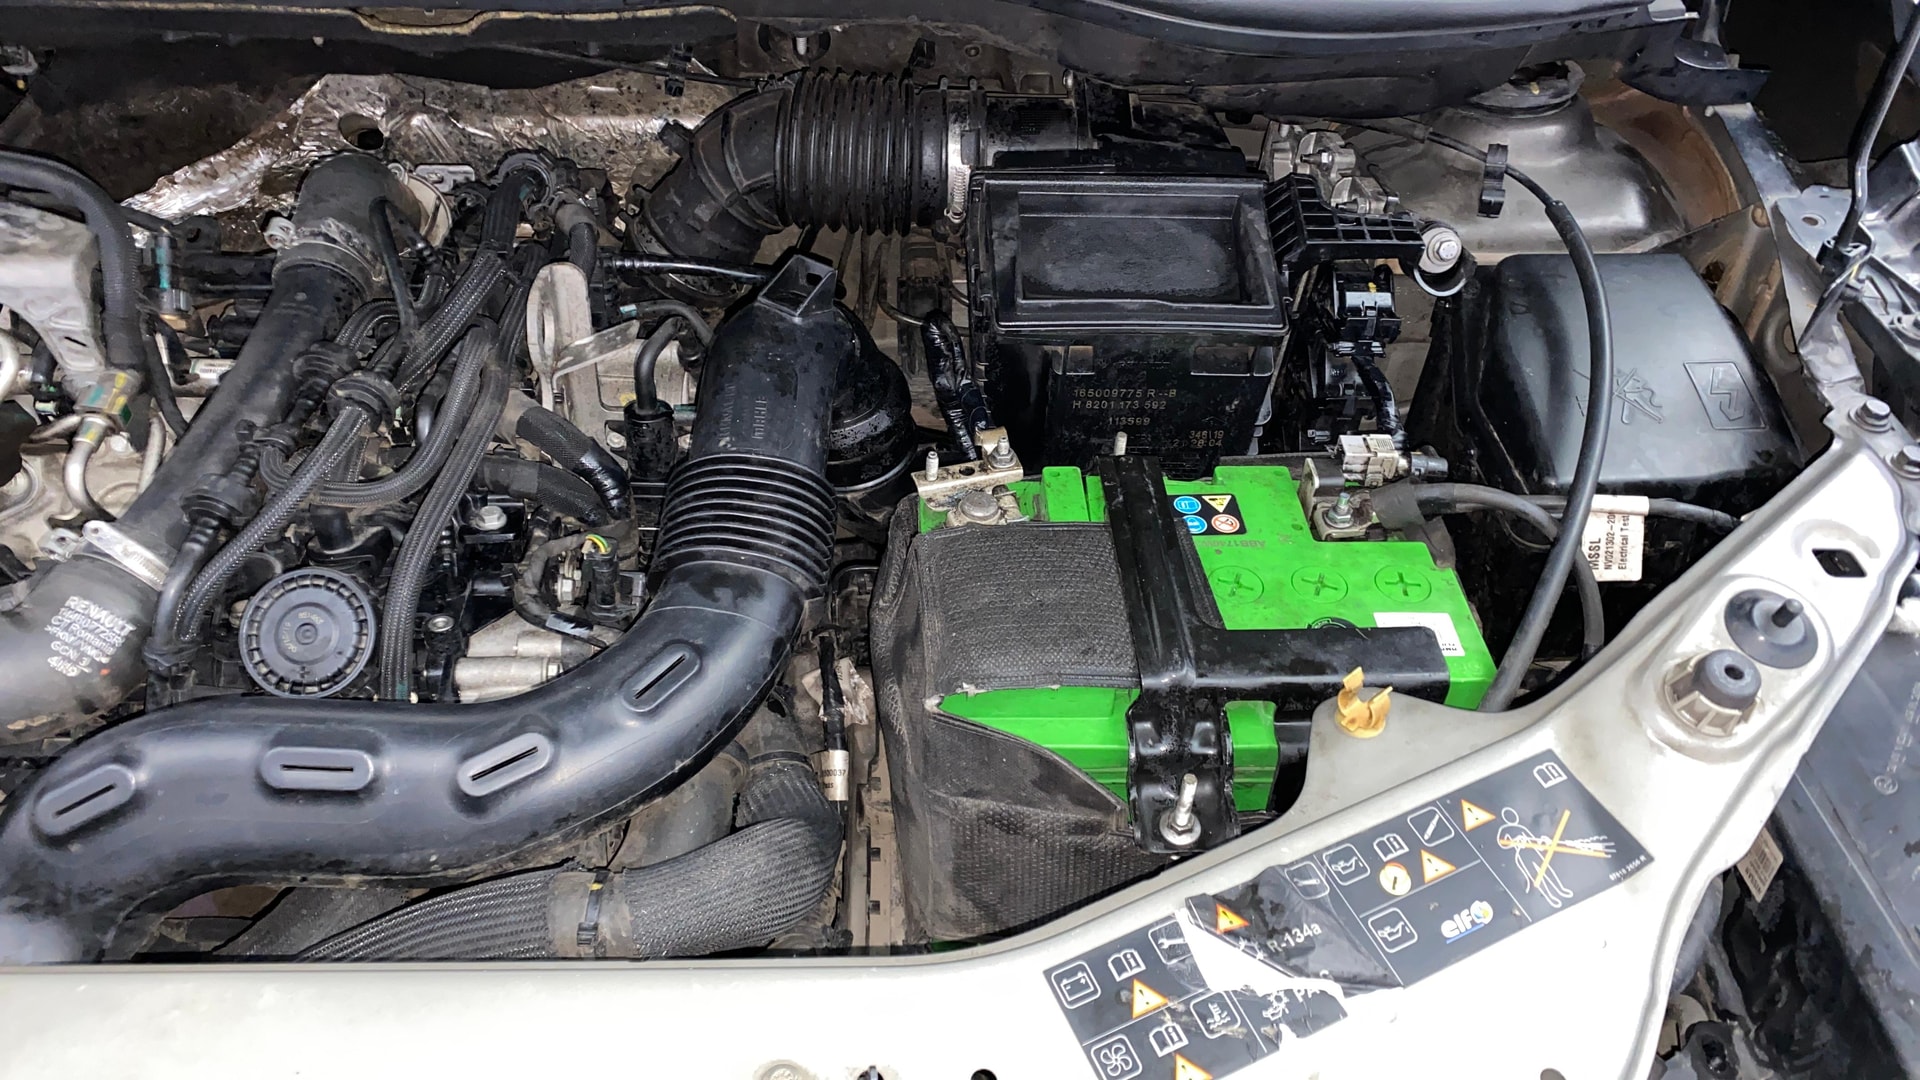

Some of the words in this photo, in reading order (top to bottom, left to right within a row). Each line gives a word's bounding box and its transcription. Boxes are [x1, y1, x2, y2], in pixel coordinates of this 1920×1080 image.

[1073, 388, 1143, 398] 165009775
[1073, 400, 1081, 409] H
[1085, 400, 1114, 409] 8201
[1144, 400, 1167, 409] 592
[1108, 416, 1150, 426] 113599
[1588, 538, 1601, 570] MSSL
[1604, 512, 1616, 570] NV021302-20
[1618, 534, 1629, 570] Electrical
[64, 595, 137, 637] RENAULT
[67, 623, 118, 656] Romania
[1266, 922, 1322, 953] R-134a
[1440, 907, 1475, 938] elf
